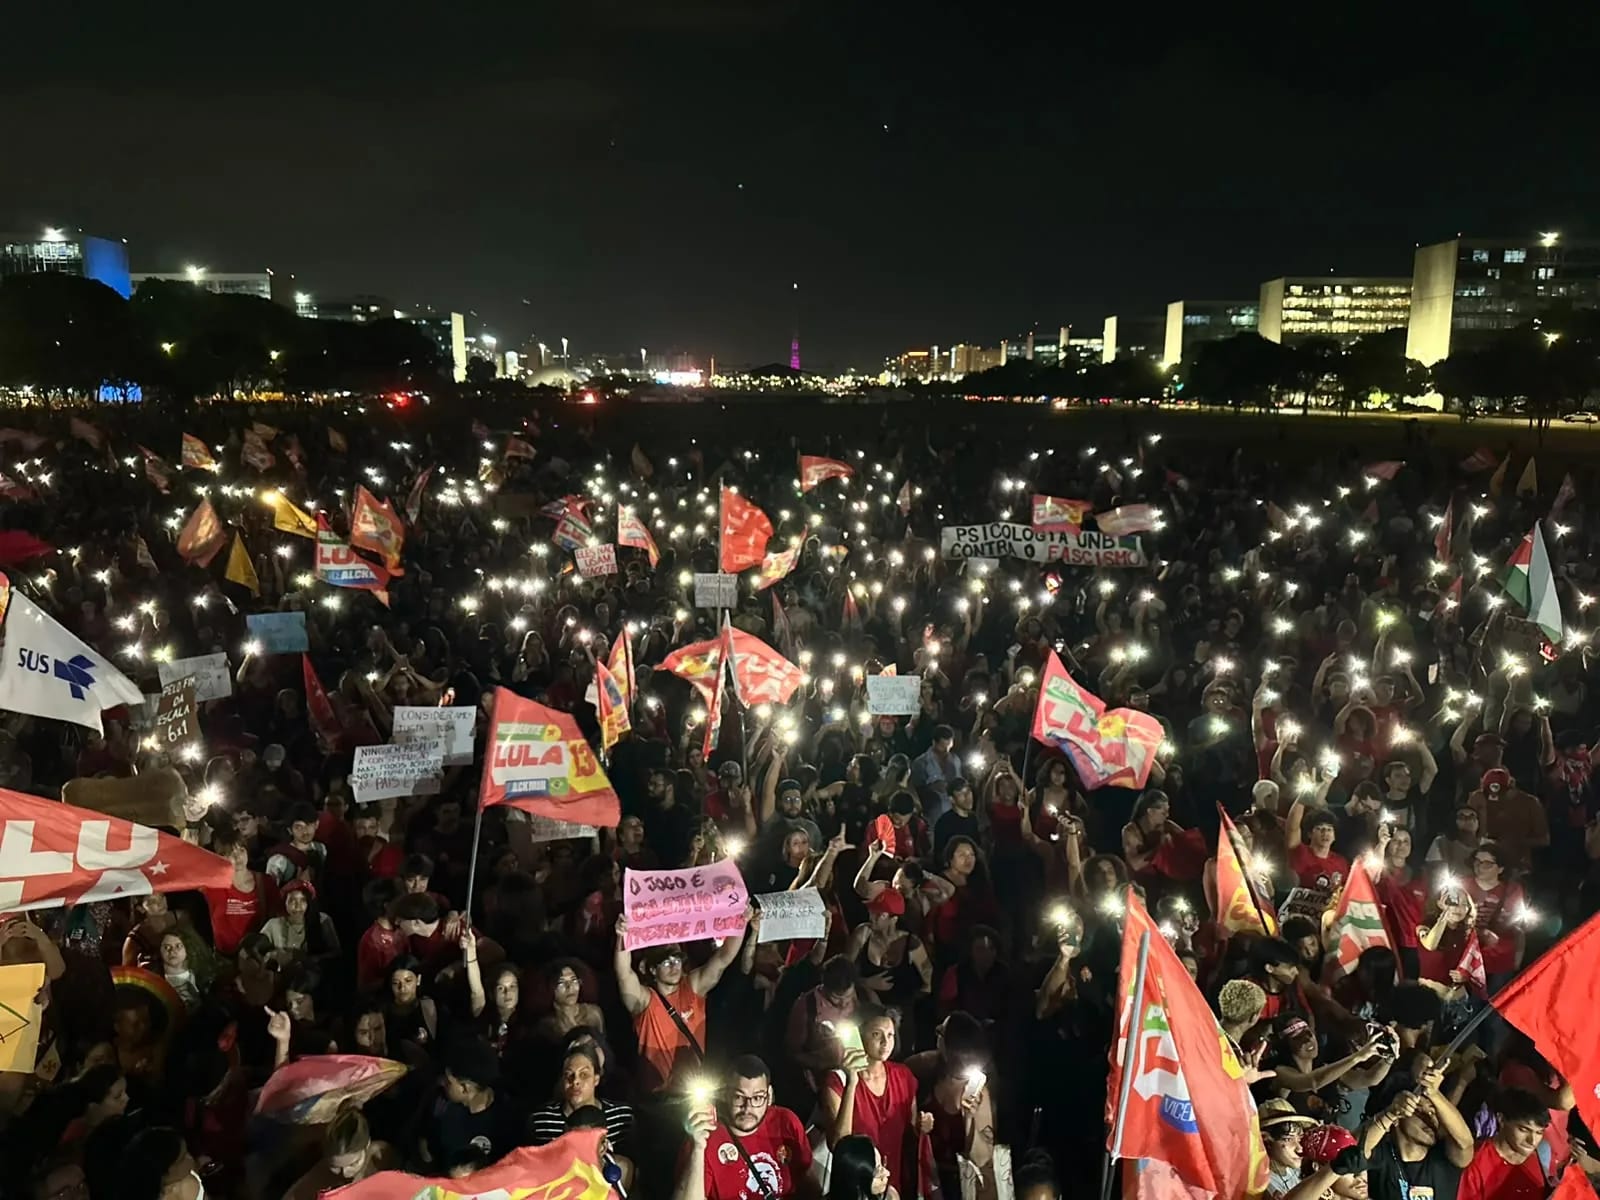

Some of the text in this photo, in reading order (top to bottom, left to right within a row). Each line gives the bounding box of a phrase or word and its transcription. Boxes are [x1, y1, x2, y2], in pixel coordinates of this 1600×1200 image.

[956, 523, 1116, 549] PSICOLOGIA UNB
[951, 540, 1140, 566] CONTRA O FASCISMO
[18, 648, 49, 674] SUS
[157, 704, 190, 725] ESCALA
[494, 743, 597, 778] LULA 13
[630, 878, 641, 895] O
[644, 874, 686, 892] JOGO
